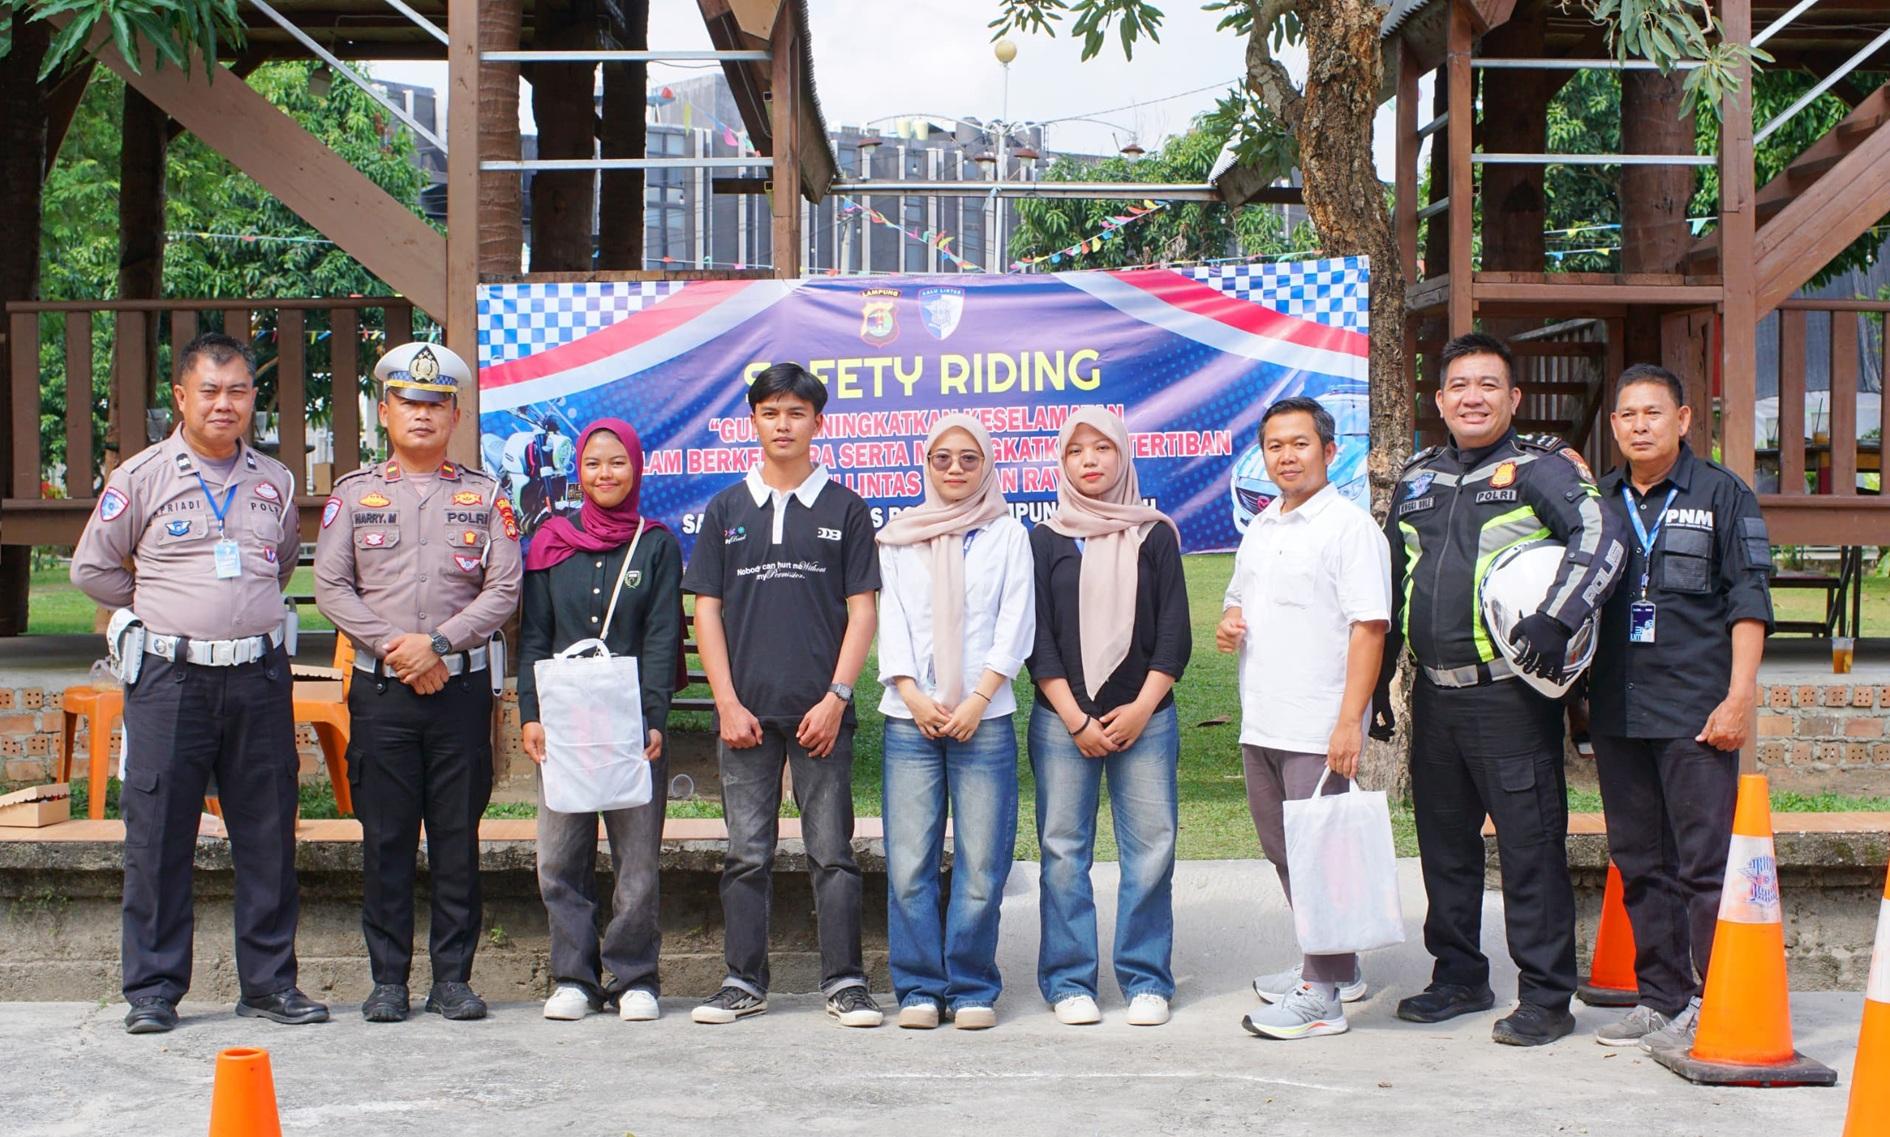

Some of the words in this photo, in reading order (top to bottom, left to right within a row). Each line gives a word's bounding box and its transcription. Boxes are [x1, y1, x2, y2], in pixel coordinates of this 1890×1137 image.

[743, 356, 924, 404] SFETY
[940, 348, 1100, 397] RIDING
[838, 436, 912, 469] SERTA
[1128, 430, 1233, 460] TERTIBAN
[1478, 490, 1514, 501] POLRI
[447, 512, 488, 524] POLRI
[1665, 508, 1714, 528] PNM
[762, 562, 776, 571] can
[777, 561, 791, 569] hurt
